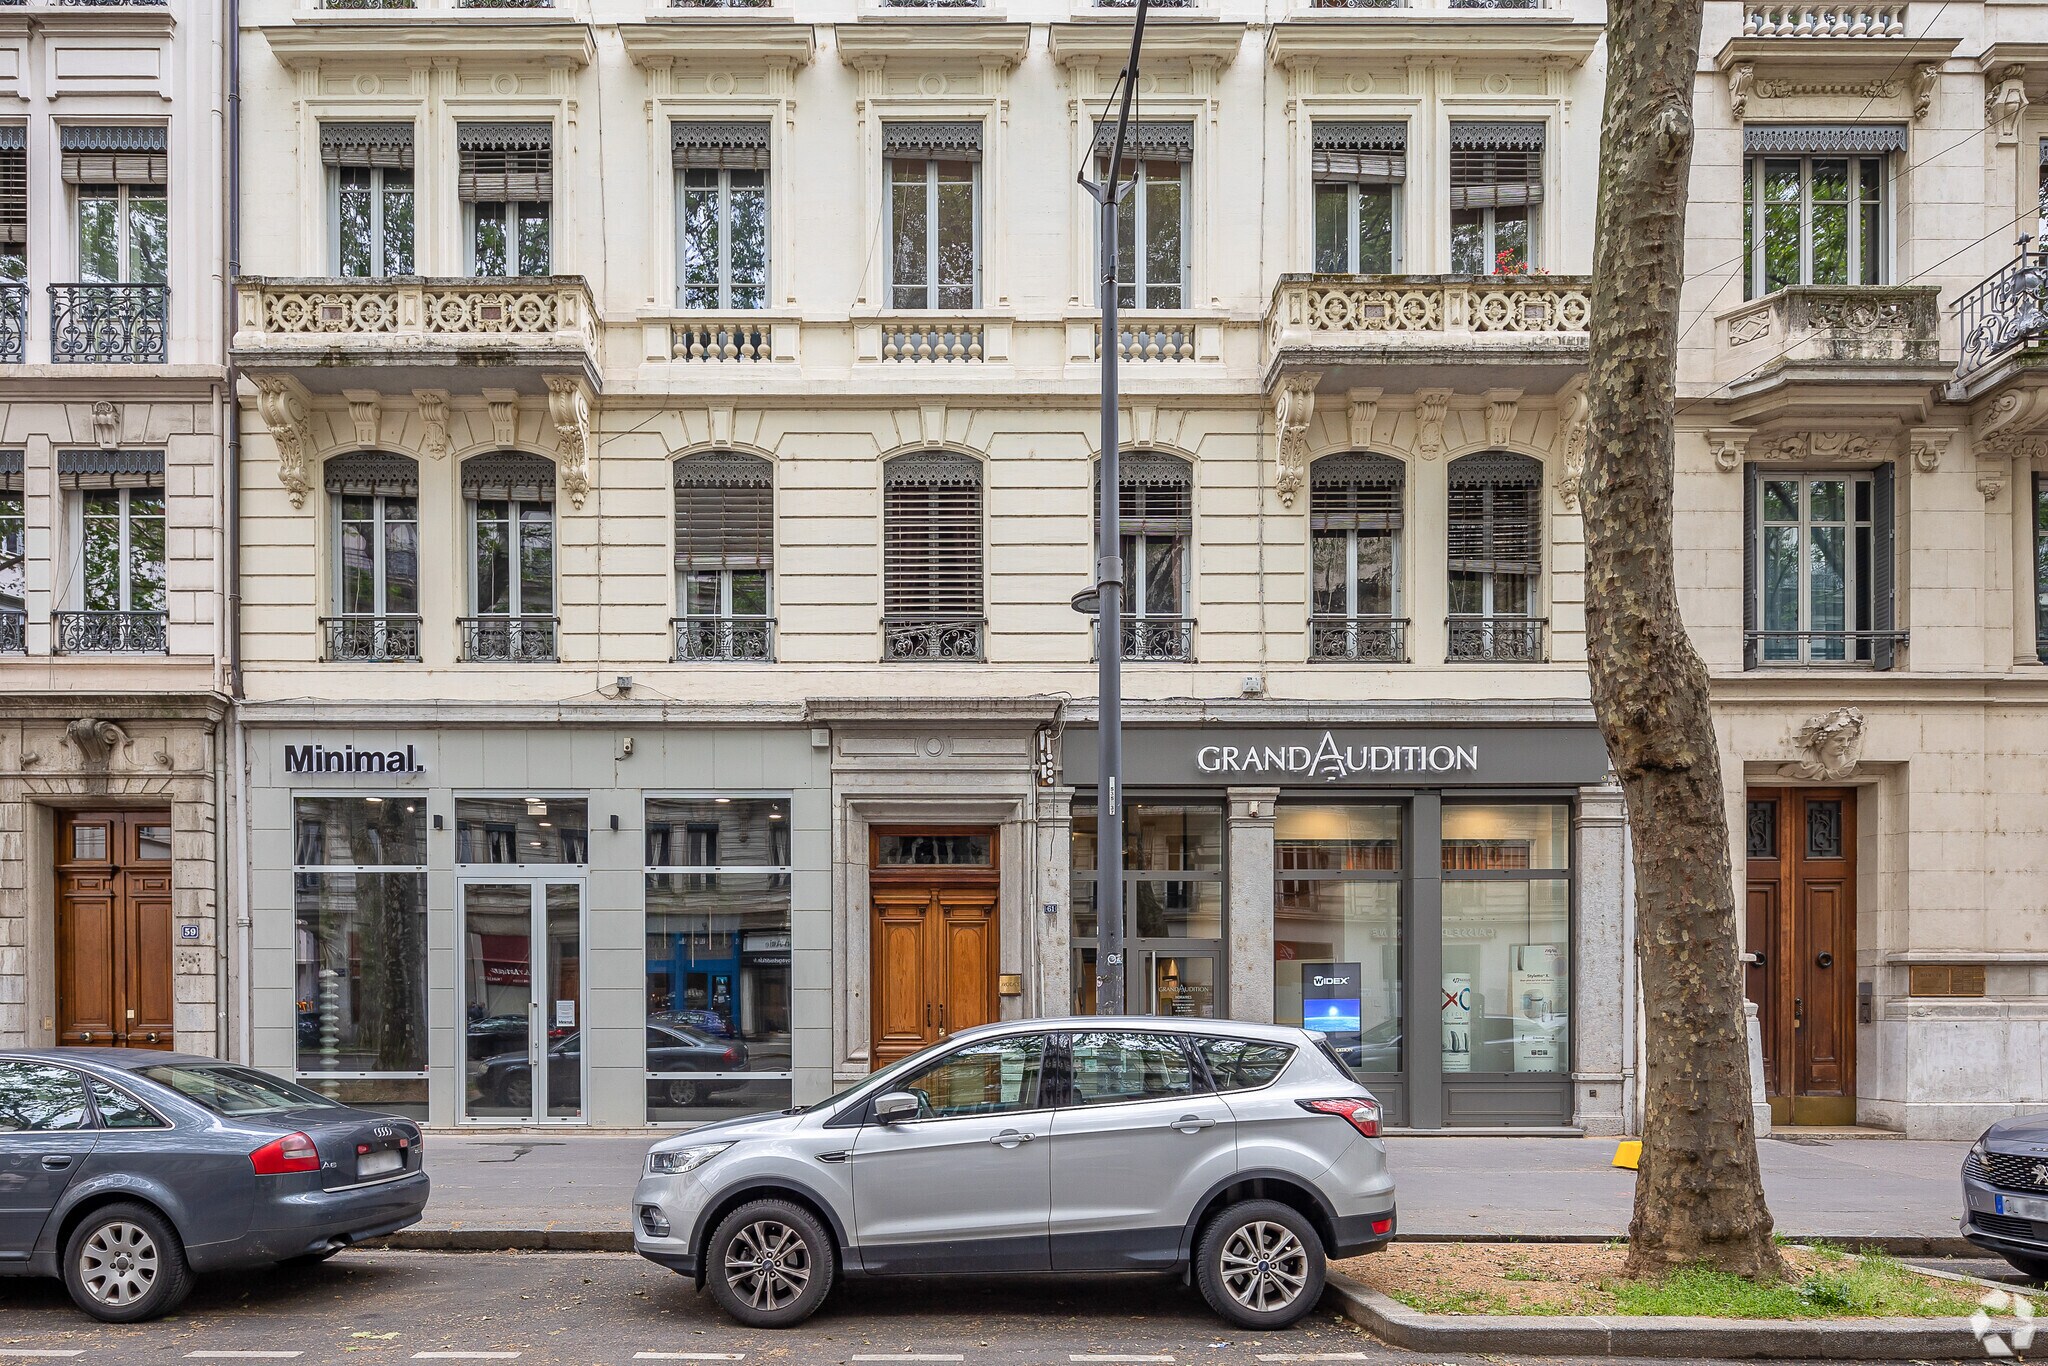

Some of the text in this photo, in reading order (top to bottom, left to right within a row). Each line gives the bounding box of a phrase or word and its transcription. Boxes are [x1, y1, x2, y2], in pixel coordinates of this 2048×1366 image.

[284, 744, 425, 772] Minimal.
[184, 927, 197, 936] 59
[1313, 975, 1349, 987] WIDEX
[322, 1161, 337, 1169] A6
